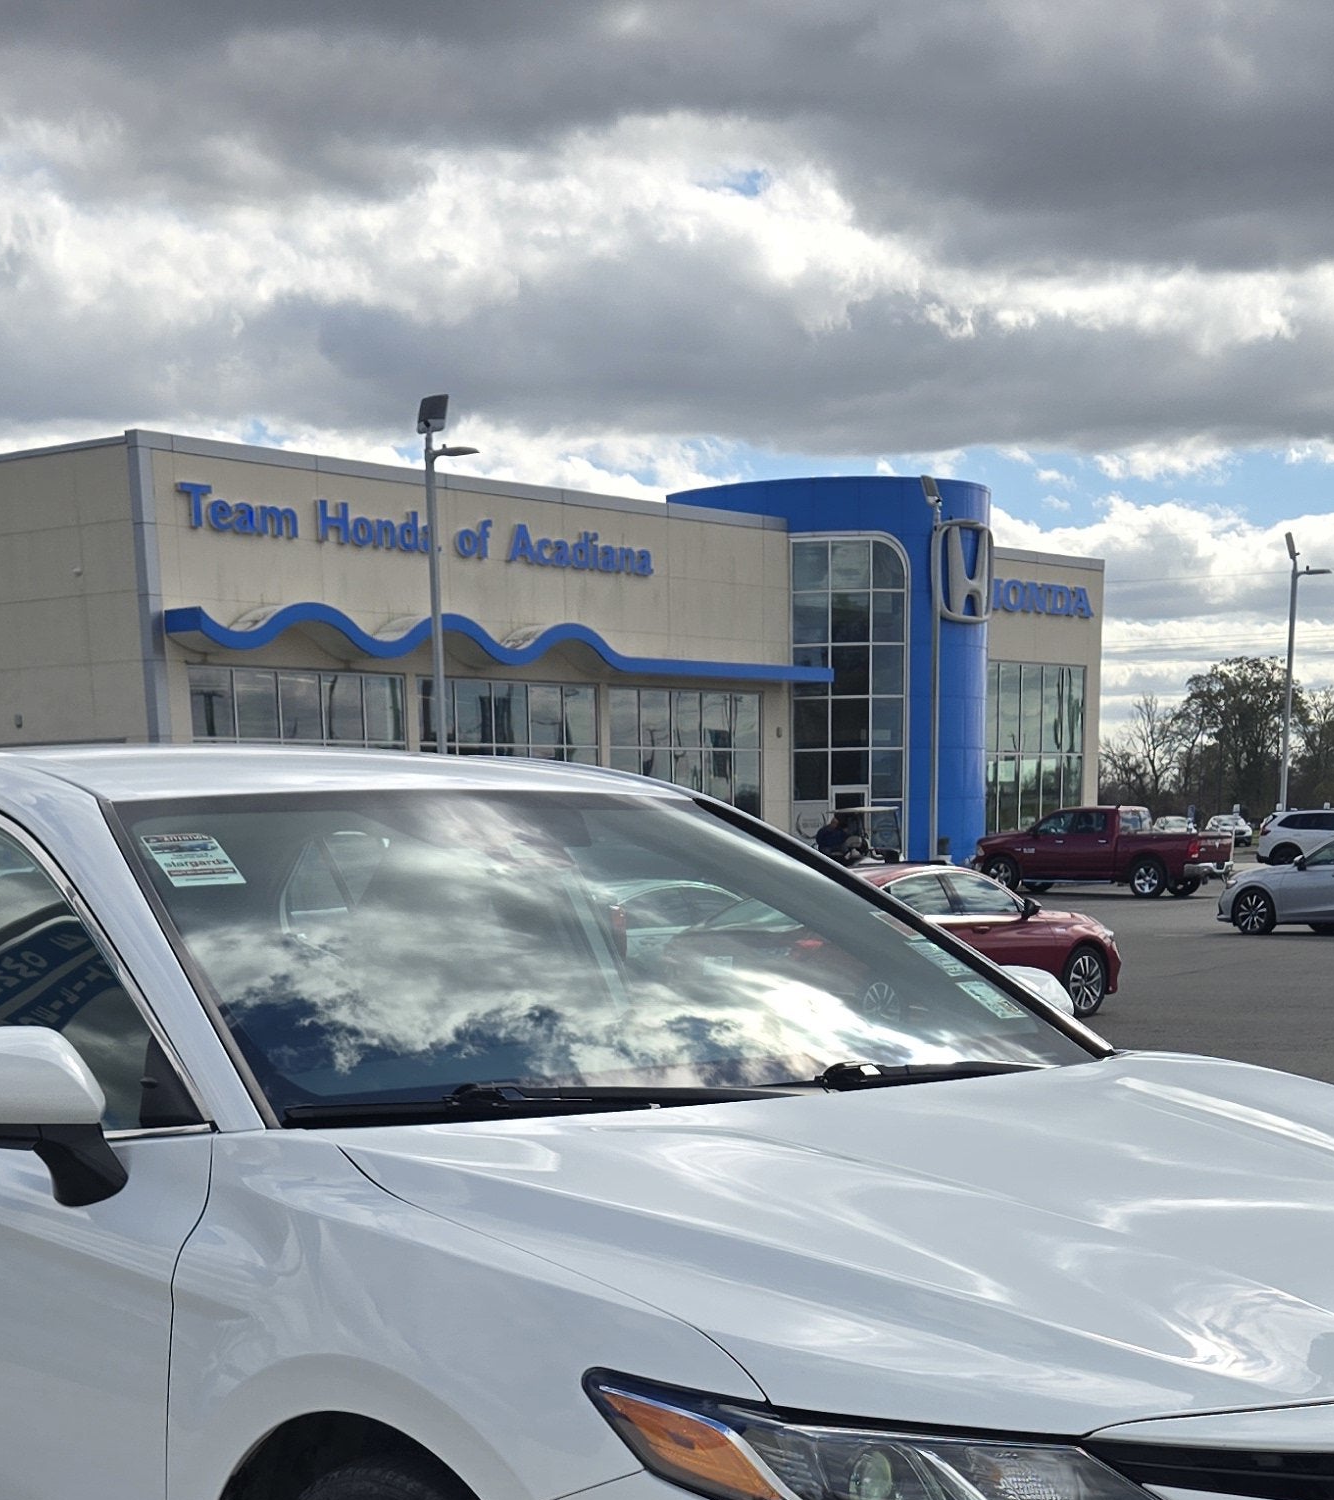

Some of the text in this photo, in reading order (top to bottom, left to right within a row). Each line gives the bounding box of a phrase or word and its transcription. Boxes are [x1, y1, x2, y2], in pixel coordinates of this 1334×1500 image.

[176, 481, 299, 540] Team
[455, 519, 493, 560] of
[506, 523, 654, 577] Acadiana
